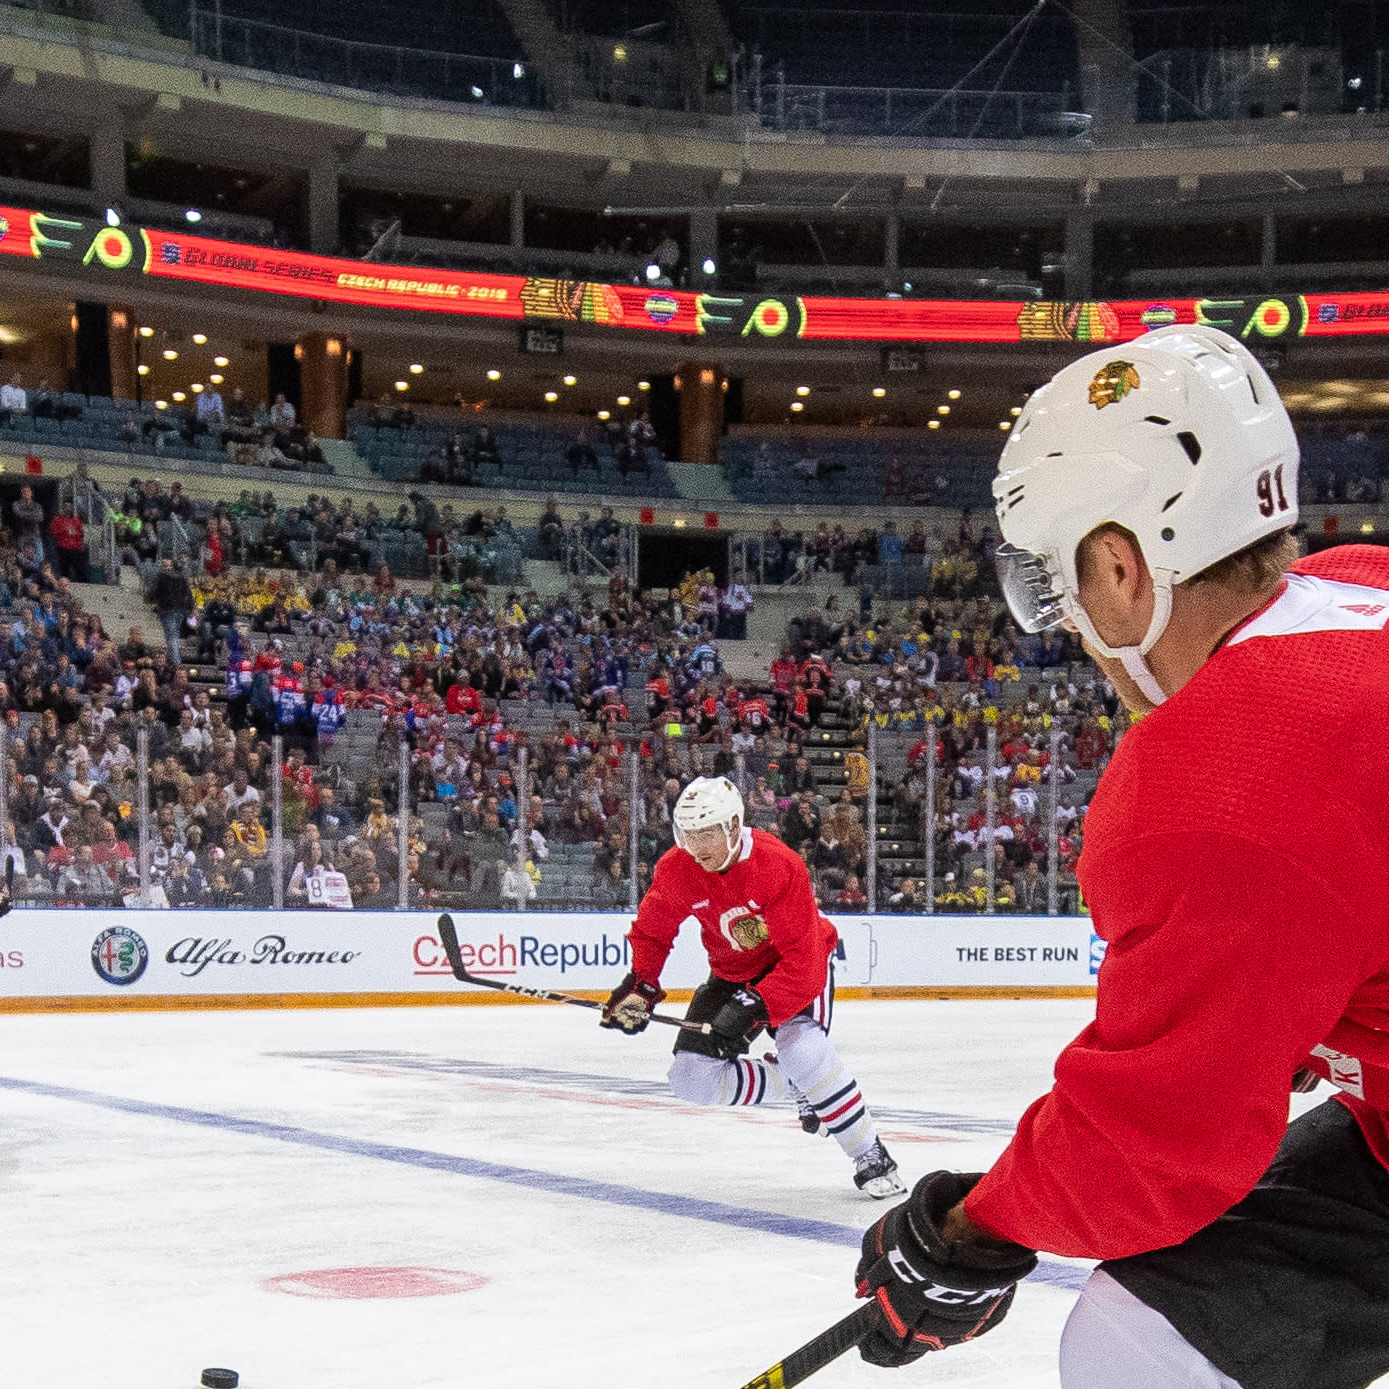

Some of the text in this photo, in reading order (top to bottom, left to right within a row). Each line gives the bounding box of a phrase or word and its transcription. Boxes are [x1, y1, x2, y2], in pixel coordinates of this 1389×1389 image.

[336, 273, 386, 289] CZECH
[386, 278, 461, 296] REPUBLIC
[1255, 463, 1289, 518] 91
[165, 934, 362, 977] Alfa Romeo
[412, 934, 629, 973] CechRepubl
[956, 947, 989, 962] THE
[994, 947, 1037, 962] BEST
[1042, 947, 1079, 962] RUN
